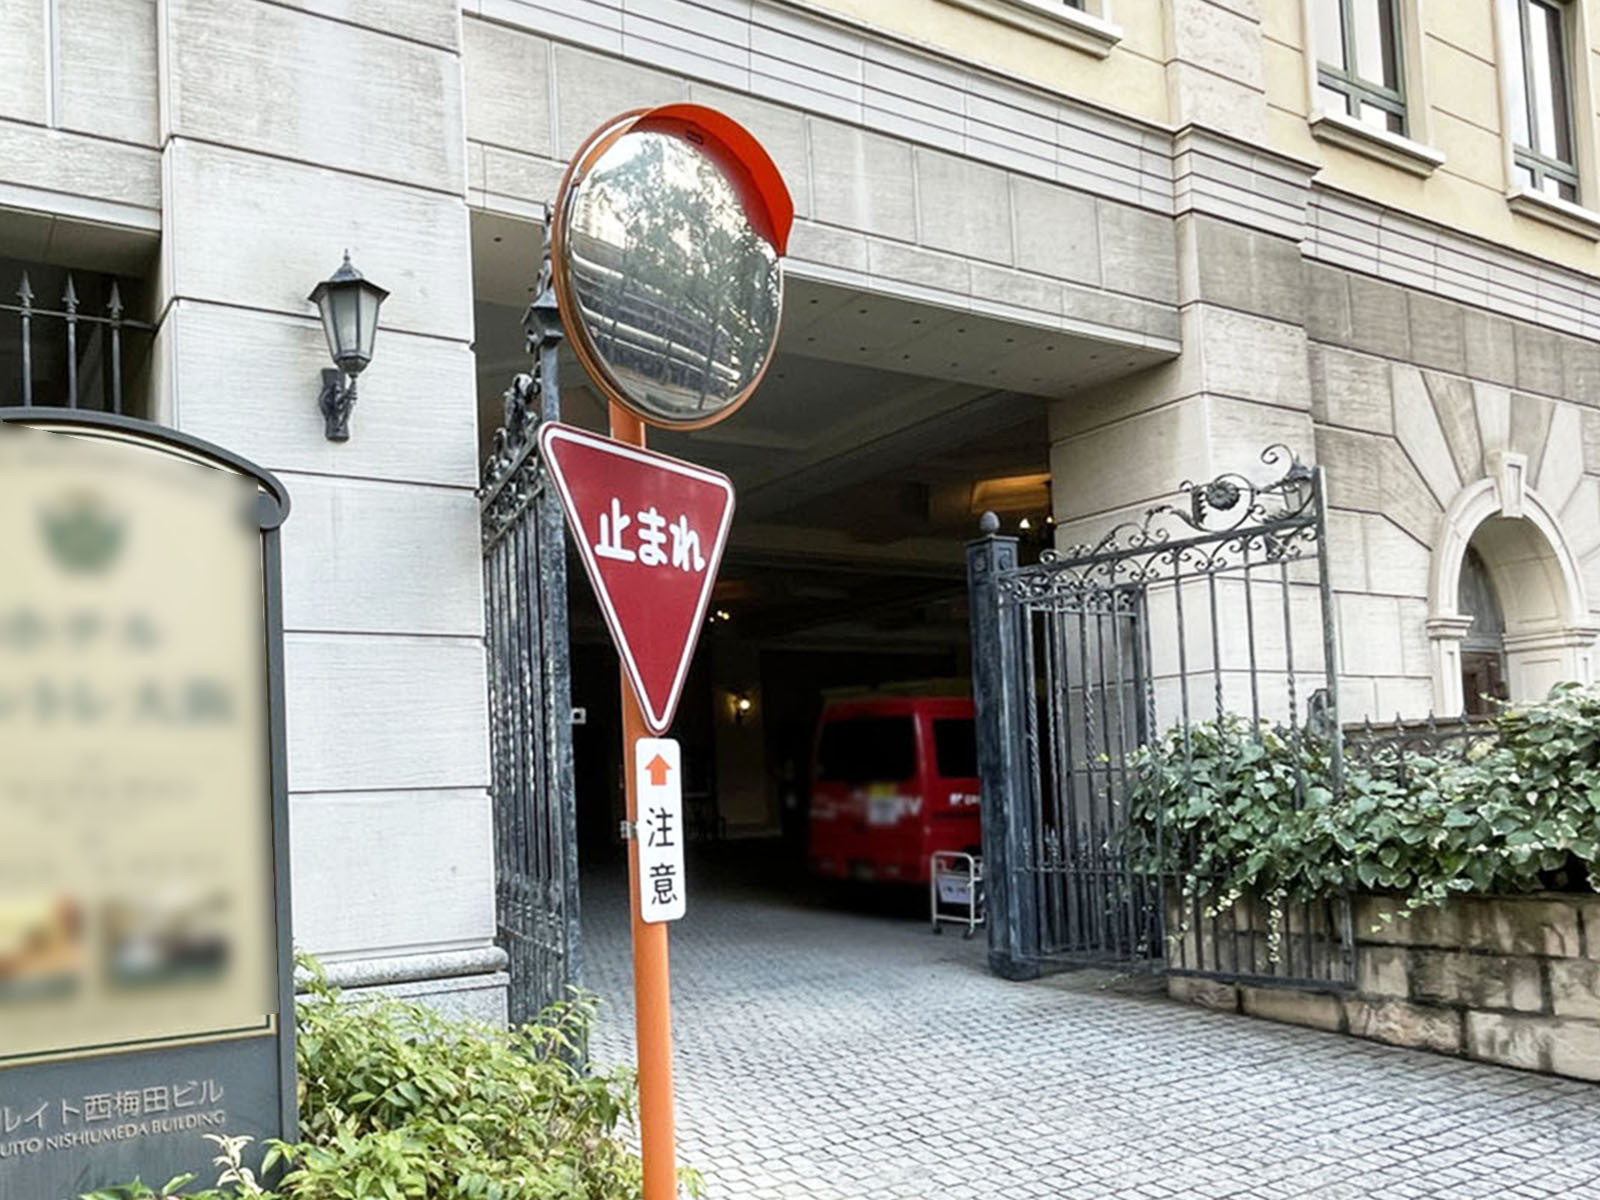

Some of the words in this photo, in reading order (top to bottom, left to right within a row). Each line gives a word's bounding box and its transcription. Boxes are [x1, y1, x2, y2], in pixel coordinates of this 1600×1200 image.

[594, 497, 706, 572] 止まれ
[646, 807, 678, 905] 注意
[46, 1124, 150, 1150] NISHIUMEDA
[152, 1109, 226, 1135] BUILDING
